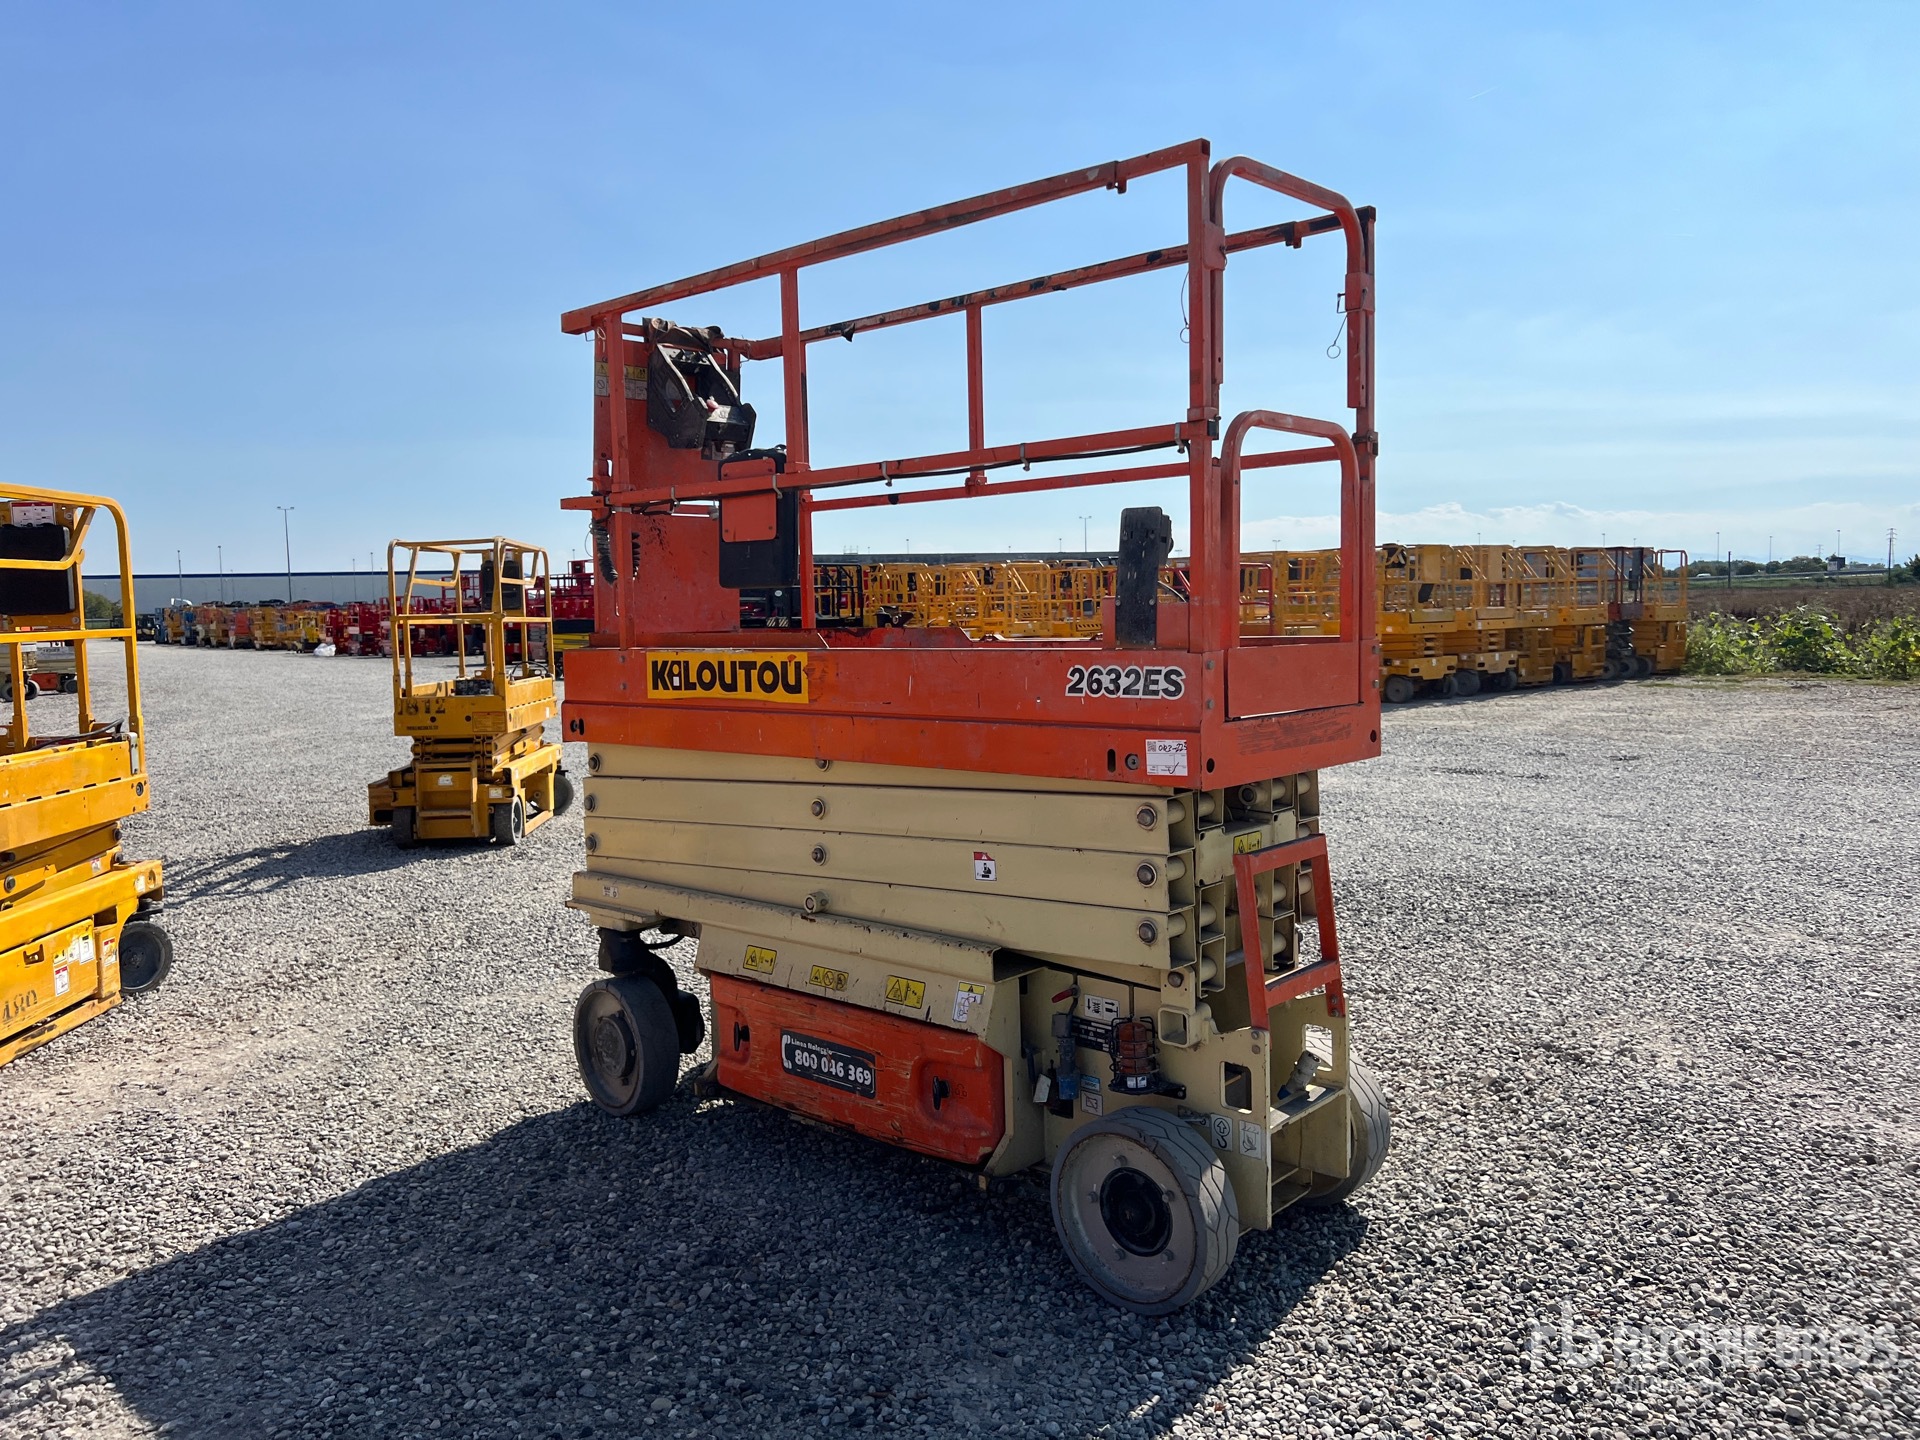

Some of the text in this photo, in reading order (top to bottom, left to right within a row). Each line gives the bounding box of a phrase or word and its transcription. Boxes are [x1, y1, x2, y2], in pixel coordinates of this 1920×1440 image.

[1066, 666, 1185, 699] 2632ES
[795, 1049, 872, 1086] 800 046 369
